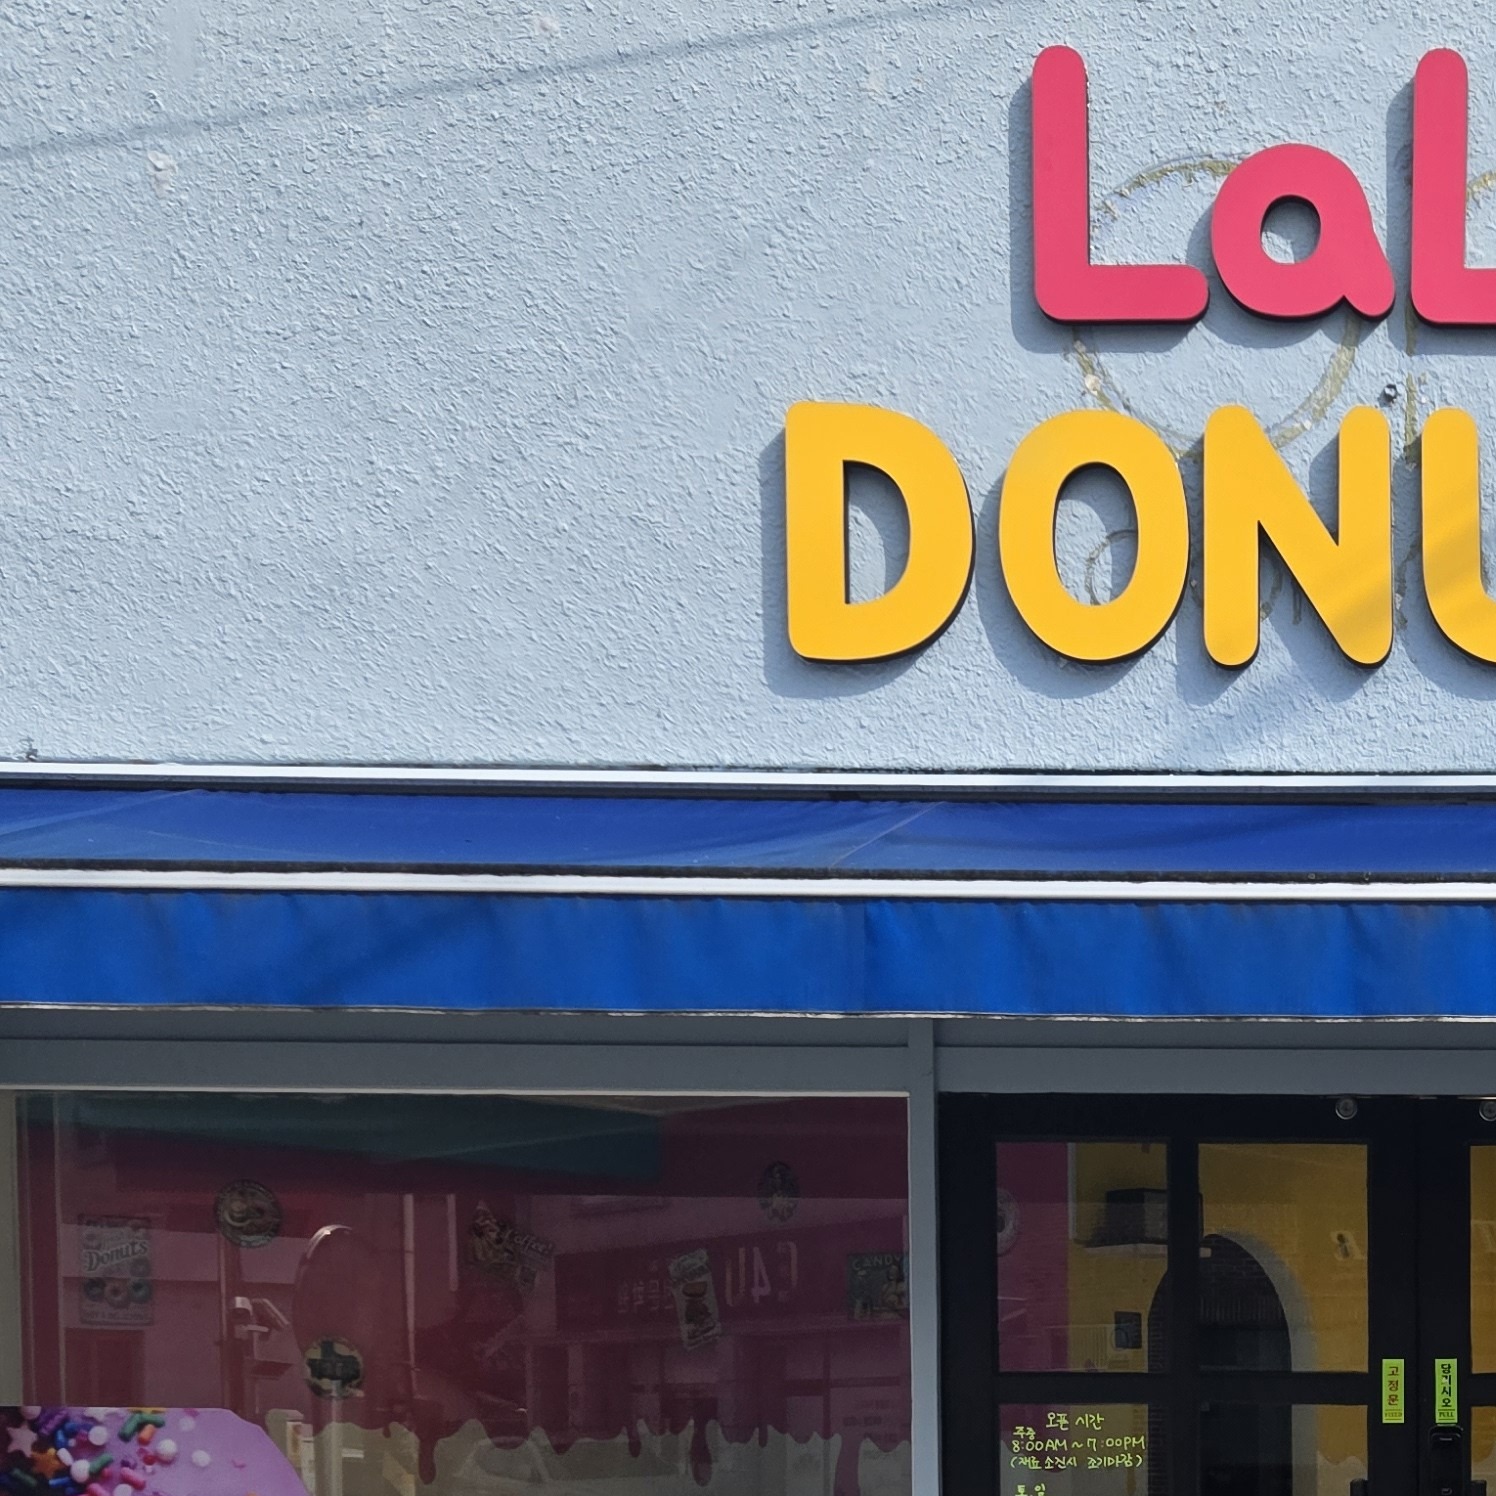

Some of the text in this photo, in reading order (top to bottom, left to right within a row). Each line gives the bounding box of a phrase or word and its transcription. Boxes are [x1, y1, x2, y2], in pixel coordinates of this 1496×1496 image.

[84, 1241, 149, 1272] Donuts
[1387, 1366, 1399, 1406] 고정문
[1441, 1363, 1452, 1408] 당기시오
[1012, 1426, 1036, 1441] 주중
[1046, 1411, 1105, 1431] 오픈 시간
